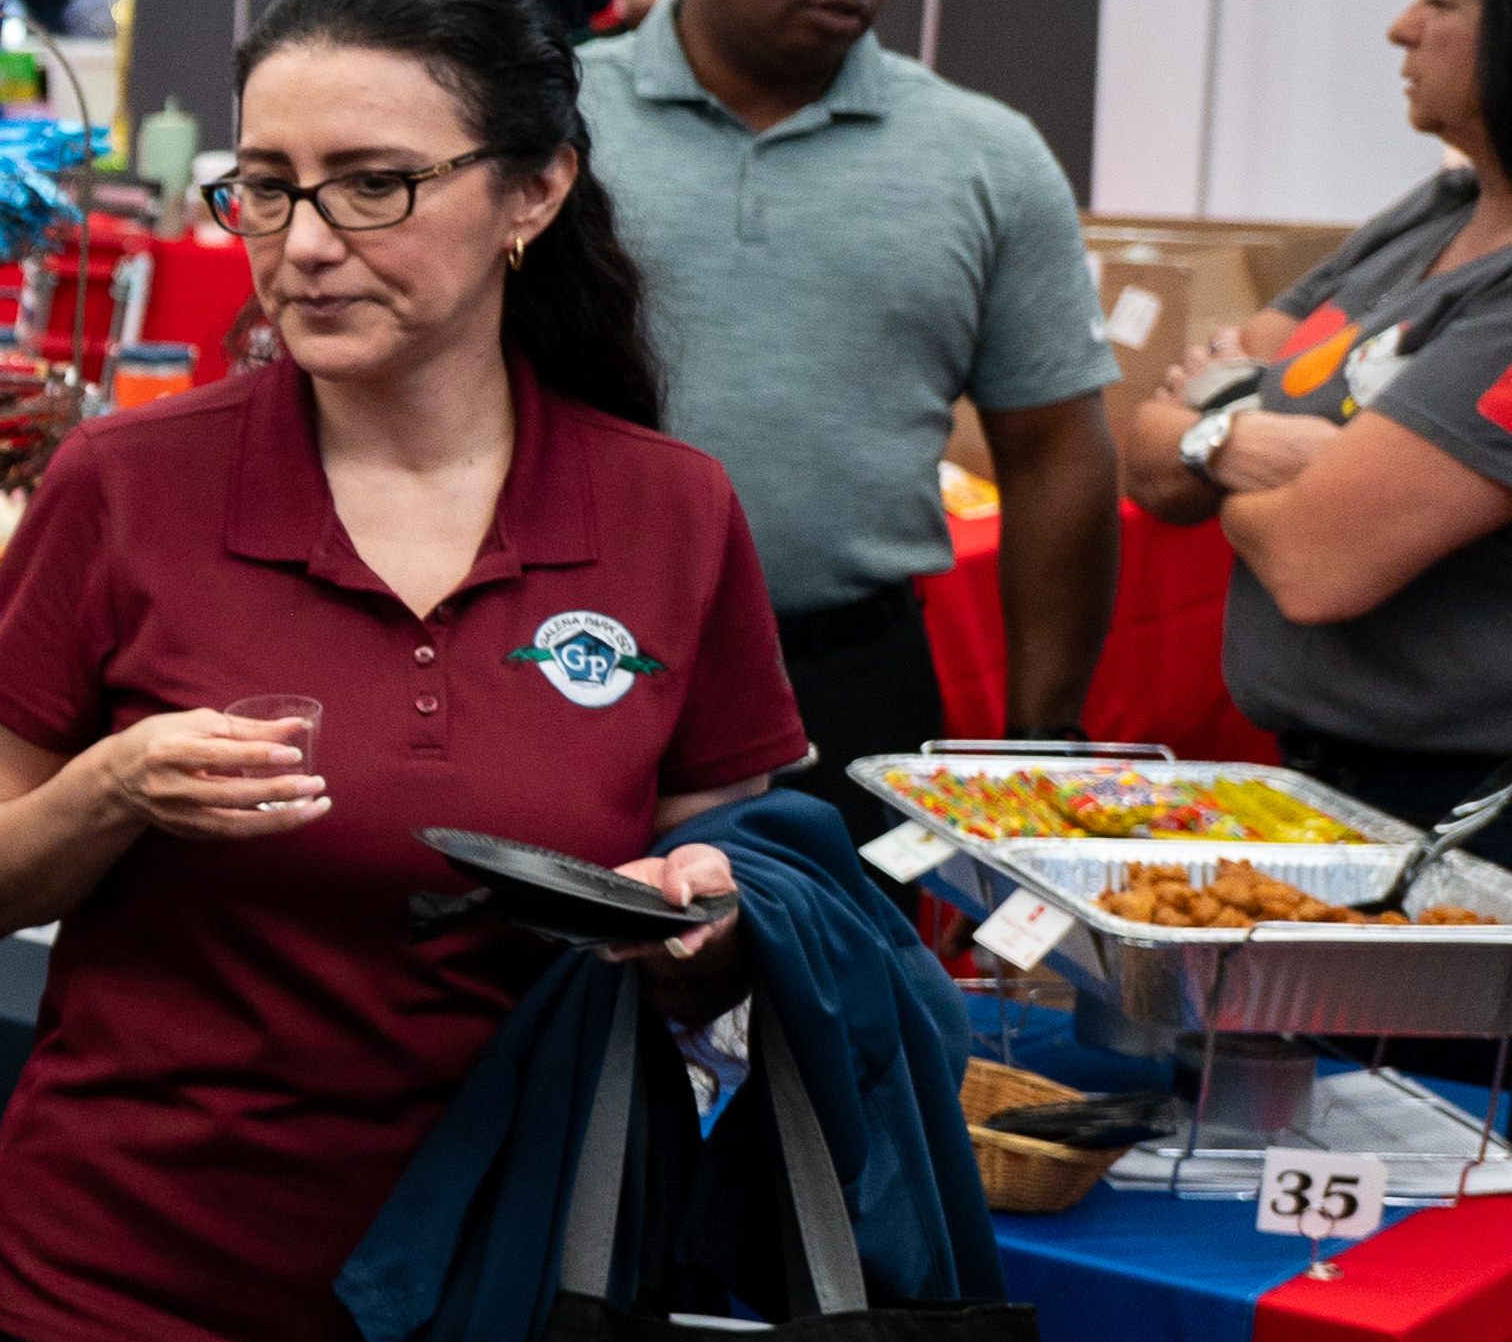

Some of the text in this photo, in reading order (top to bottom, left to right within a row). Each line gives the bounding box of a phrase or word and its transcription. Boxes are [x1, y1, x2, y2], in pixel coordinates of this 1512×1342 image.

[539, 616, 580, 647] GALENA
[583, 616, 616, 634] PARK
[1268, 1168, 1363, 1220] 35
